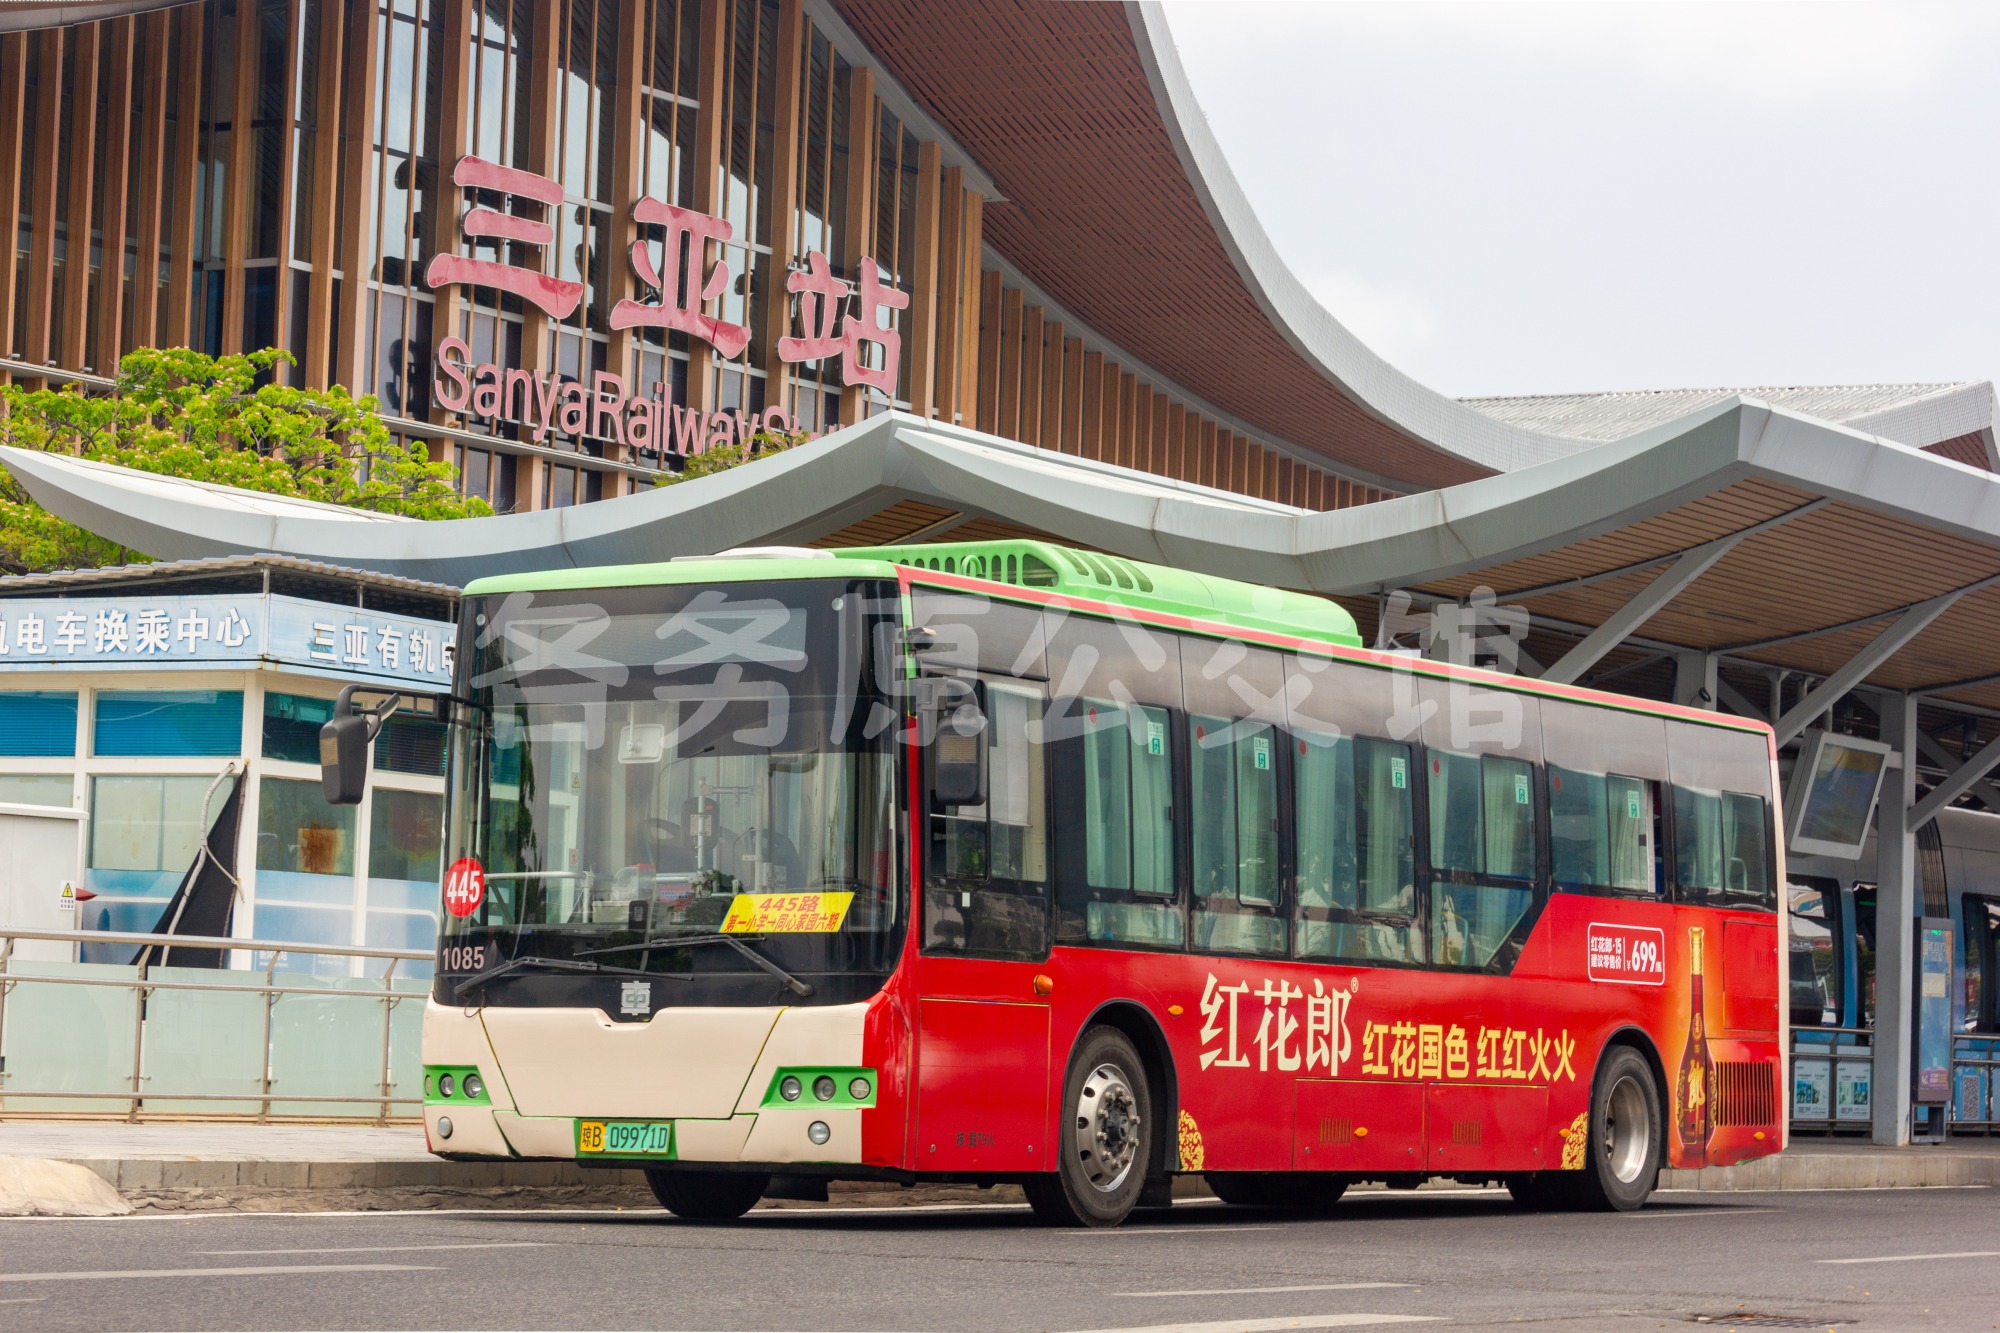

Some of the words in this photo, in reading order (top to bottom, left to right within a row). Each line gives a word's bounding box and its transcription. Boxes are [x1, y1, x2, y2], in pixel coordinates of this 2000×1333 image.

[425, 154, 909, 396] 三亚站
[446, 870, 481, 904] 445
[759, 895, 821, 913] 445路
[442, 945, 485, 971] 1085
[1361, 1019, 1469, 1080] 红花国色
[1475, 1026, 1577, 1083] 红红火火
